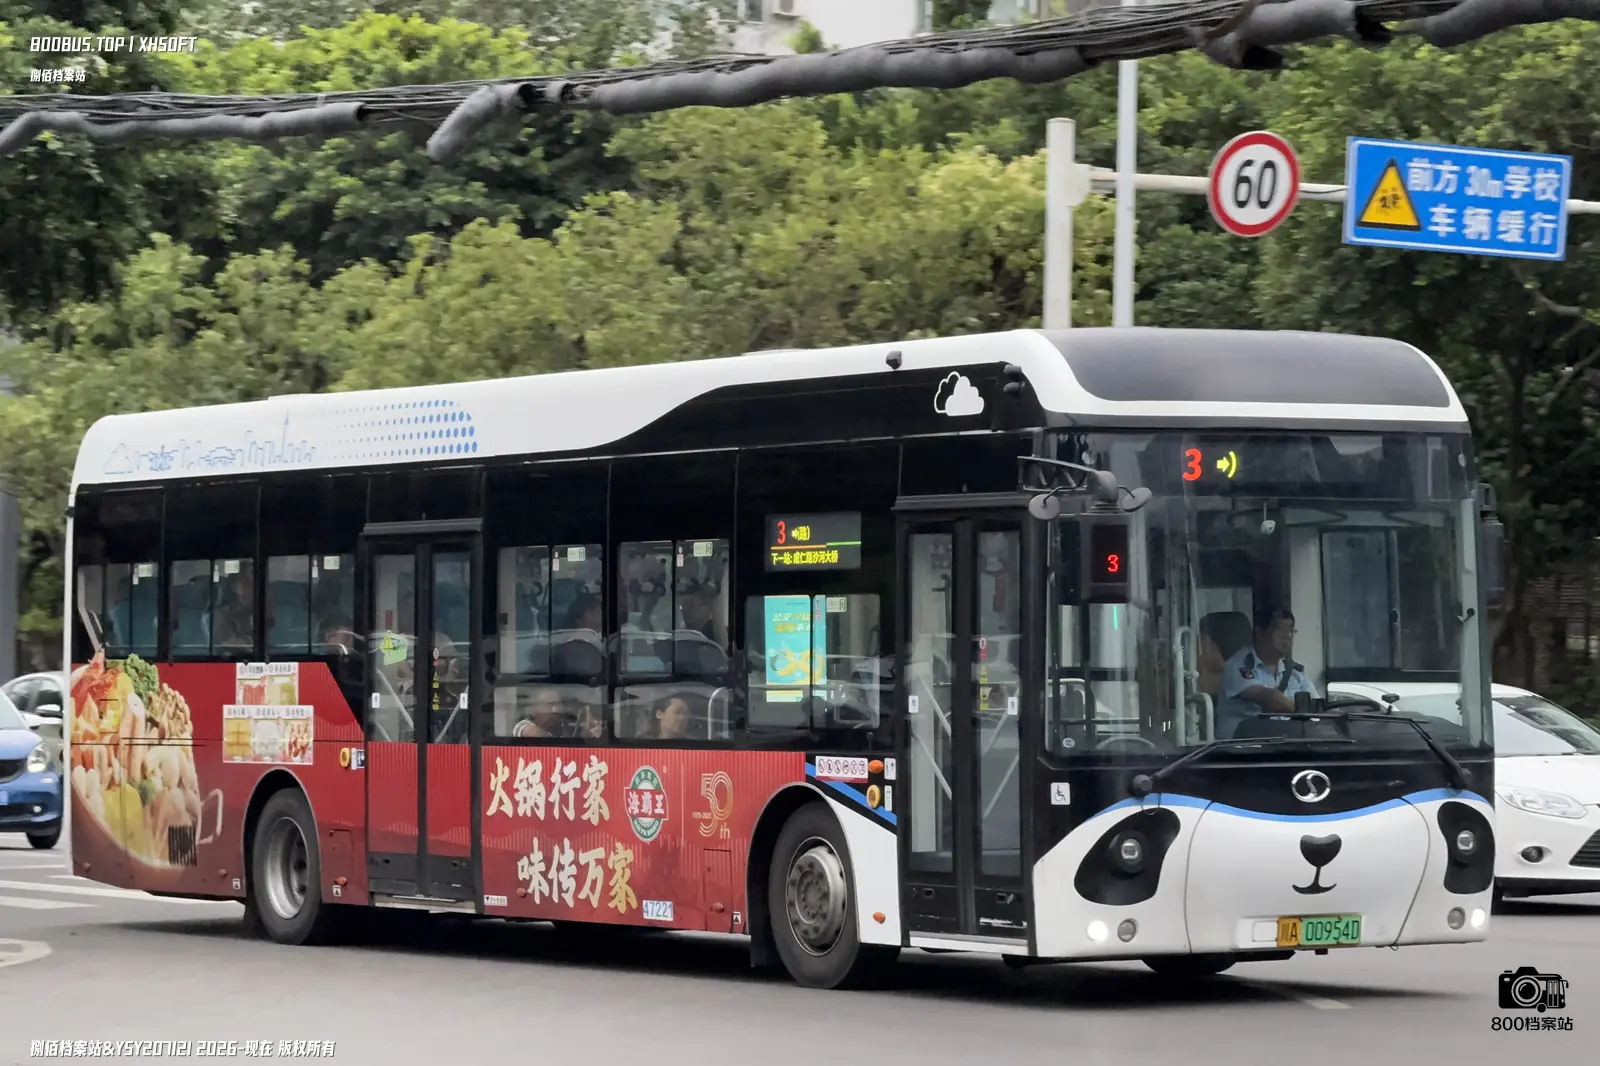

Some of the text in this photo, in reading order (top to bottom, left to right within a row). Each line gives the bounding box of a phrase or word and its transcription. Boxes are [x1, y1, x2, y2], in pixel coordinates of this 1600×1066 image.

[1234, 159, 1276, 209] 60
[1427, 203, 1558, 245] 车辆缓行
[1182, 448, 1202, 481] 3
[777, 521, 786, 544] 3
[1107, 554, 1119, 572] 3
[486, 755, 610, 826] 火锅行家
[628, 791, 665, 816] 海霸王
[517, 837, 637, 914] 味传万家
[644, 901, 673, 918] 47221
